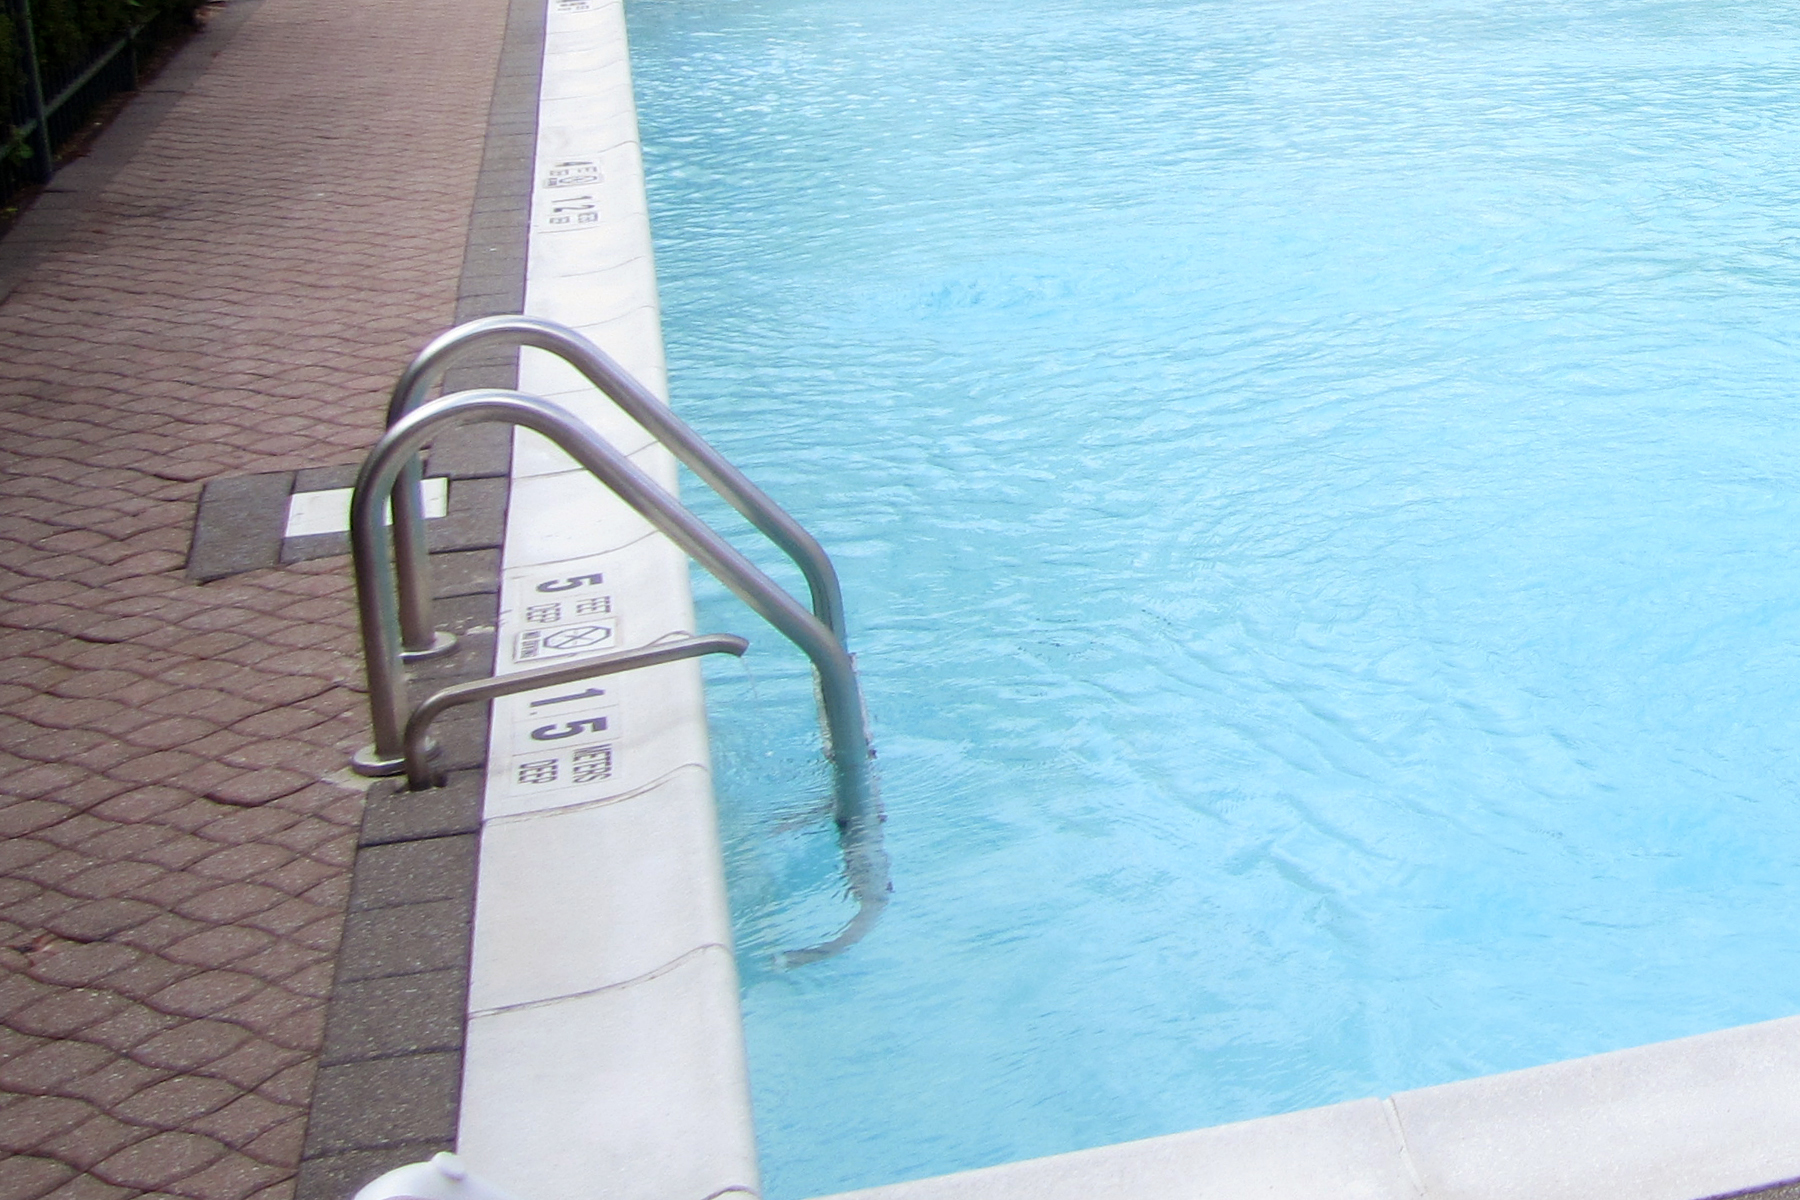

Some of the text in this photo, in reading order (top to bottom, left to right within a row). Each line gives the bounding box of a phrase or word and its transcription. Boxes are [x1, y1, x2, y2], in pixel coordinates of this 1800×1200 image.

[536, 573, 611, 616] 5 FEET
[526, 602, 561, 623] DEEP
[518, 758, 559, 784] DEEP
[572, 743, 612, 784] METERS
